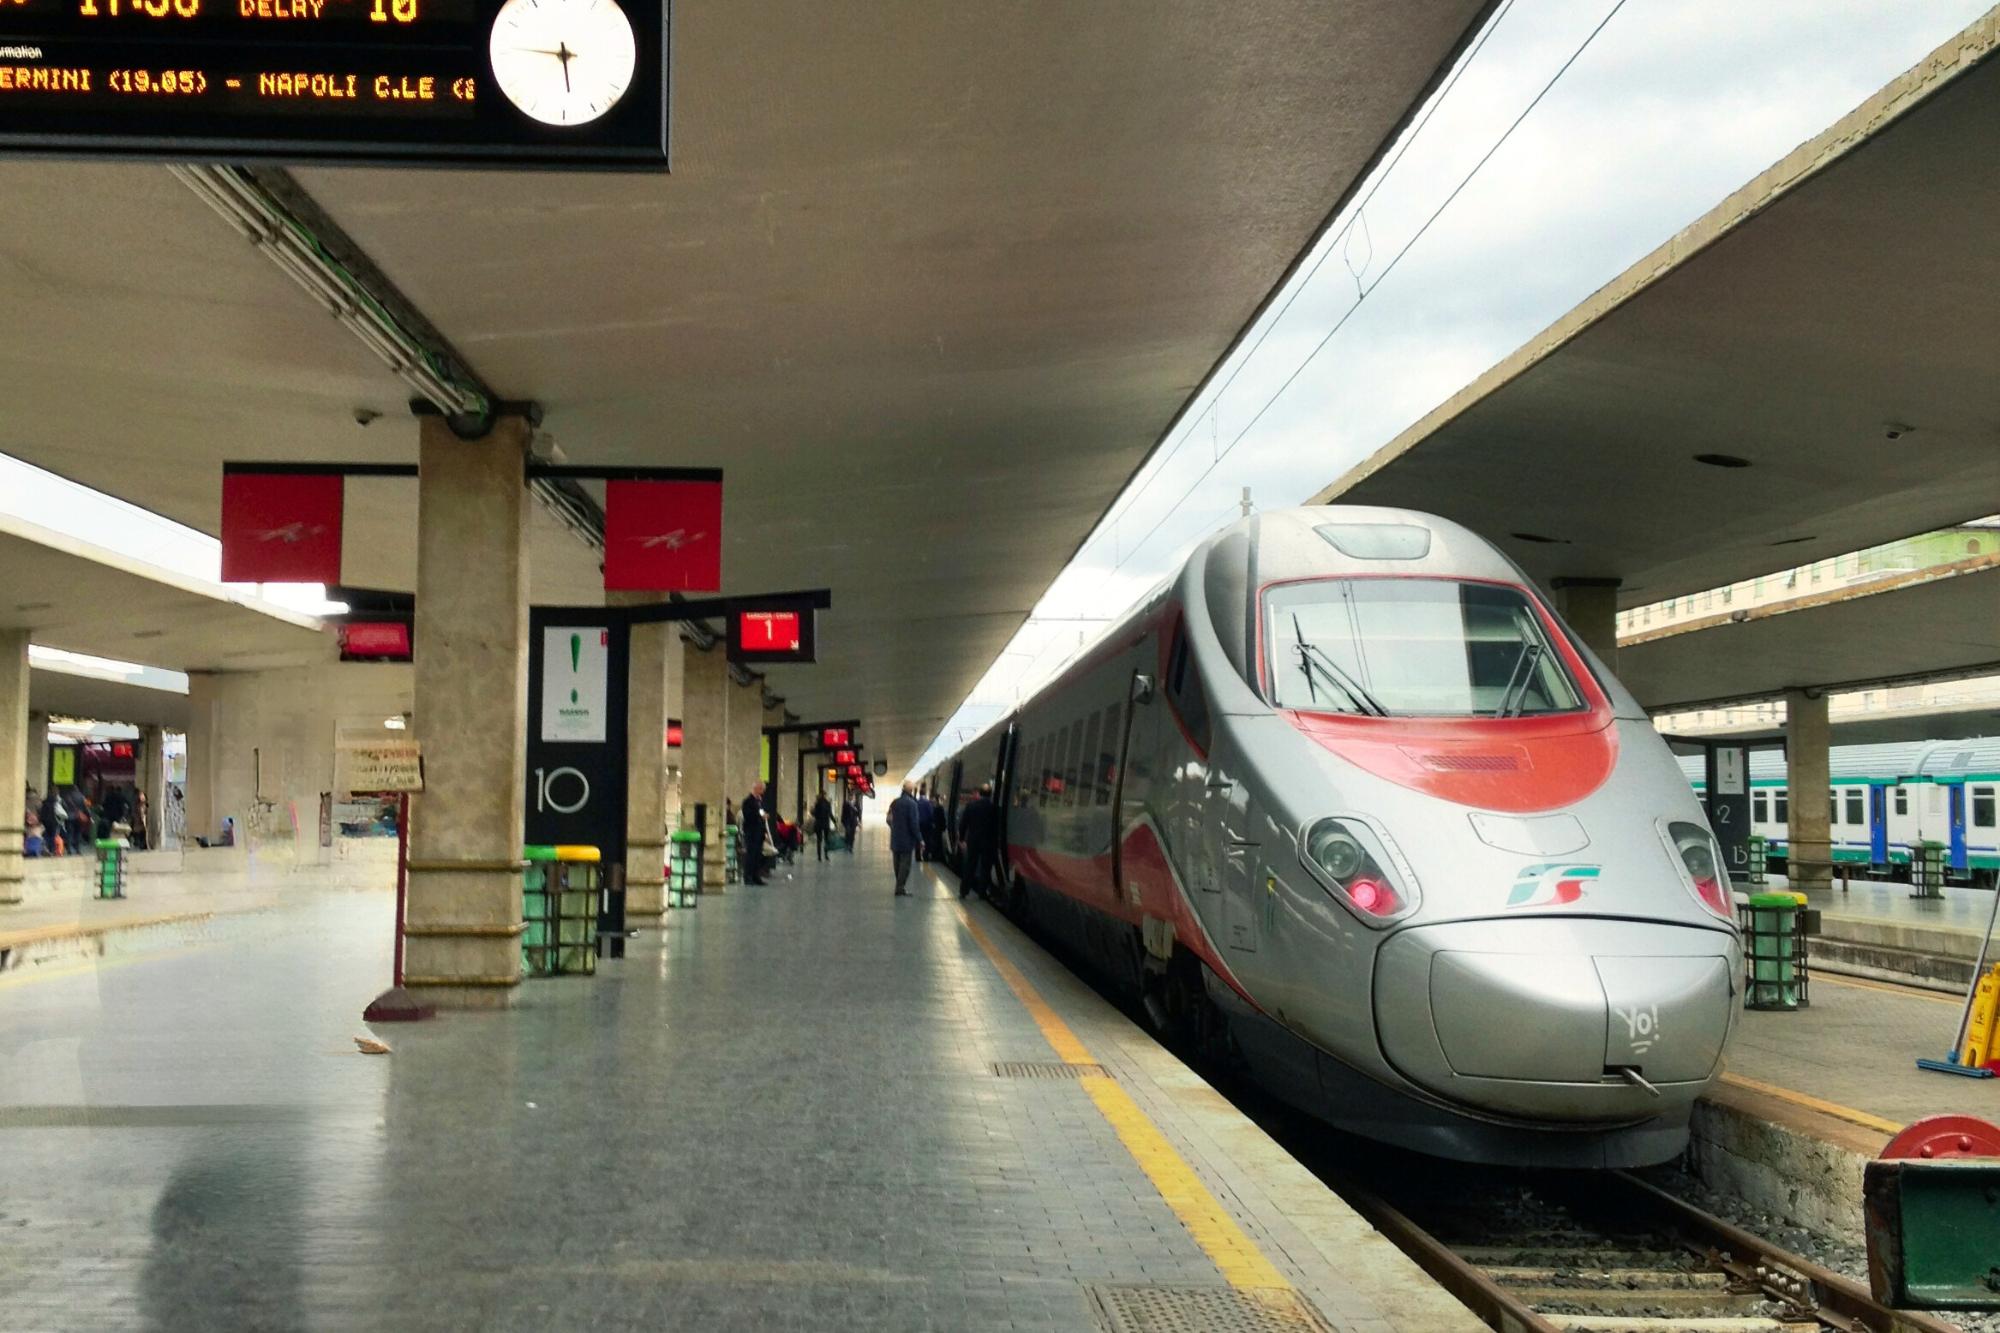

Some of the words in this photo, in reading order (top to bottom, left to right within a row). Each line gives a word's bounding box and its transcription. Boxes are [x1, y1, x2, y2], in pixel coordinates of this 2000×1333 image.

[259, 73, 356, 97] NAPOLI
[375, 75, 434, 99] C.LE
[535, 766, 590, 814] 10
